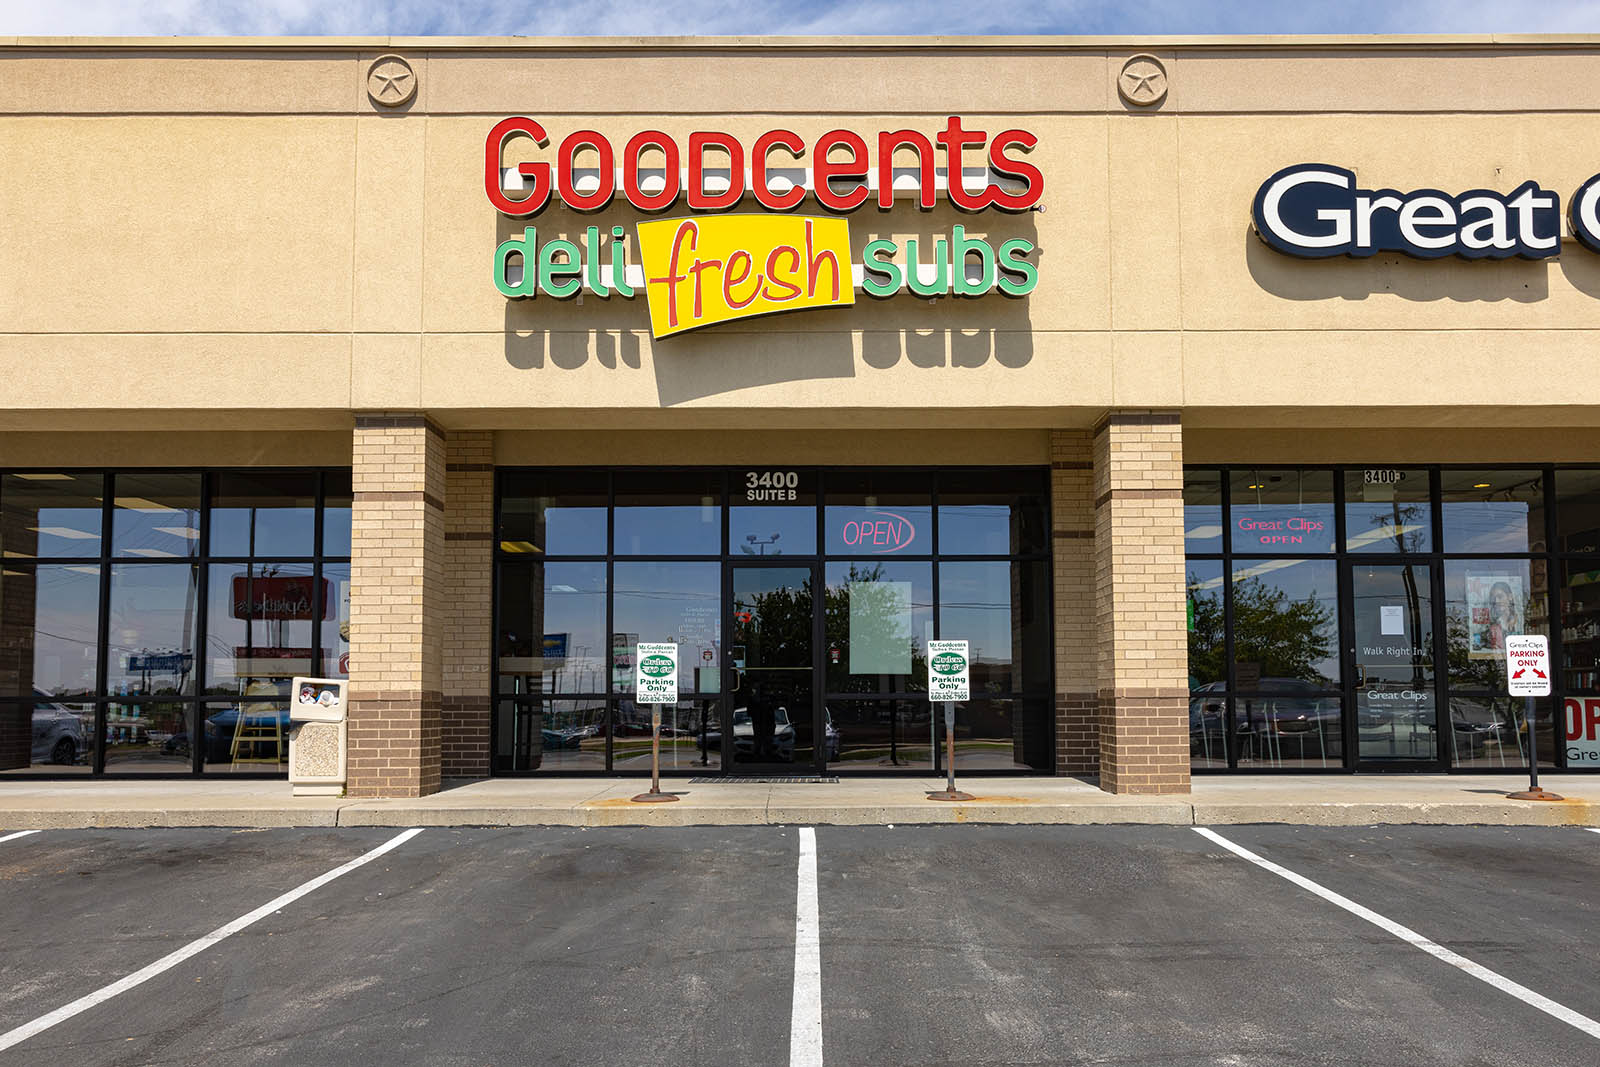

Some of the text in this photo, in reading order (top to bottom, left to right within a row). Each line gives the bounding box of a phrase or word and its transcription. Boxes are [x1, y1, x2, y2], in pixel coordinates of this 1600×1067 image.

[1262, 170, 1557, 250] Great
[493, 220, 1040, 329] deli fresh subs
[746, 471, 799, 488] 3400
[747, 490, 797, 501] SUITE B
[843, 521, 903, 545] OPEN
[1238, 517, 1324, 534] Great Clips
[1260, 535, 1303, 544] OPEN
[1362, 646, 1384, 655] Walk
[1386, 646, 1410, 657] Right
[640, 678, 674, 686] Parking
[1367, 690, 1427, 702] Great Clips
[1564, 698, 1600, 741] OP
[1567, 747, 1600, 761] Gre
